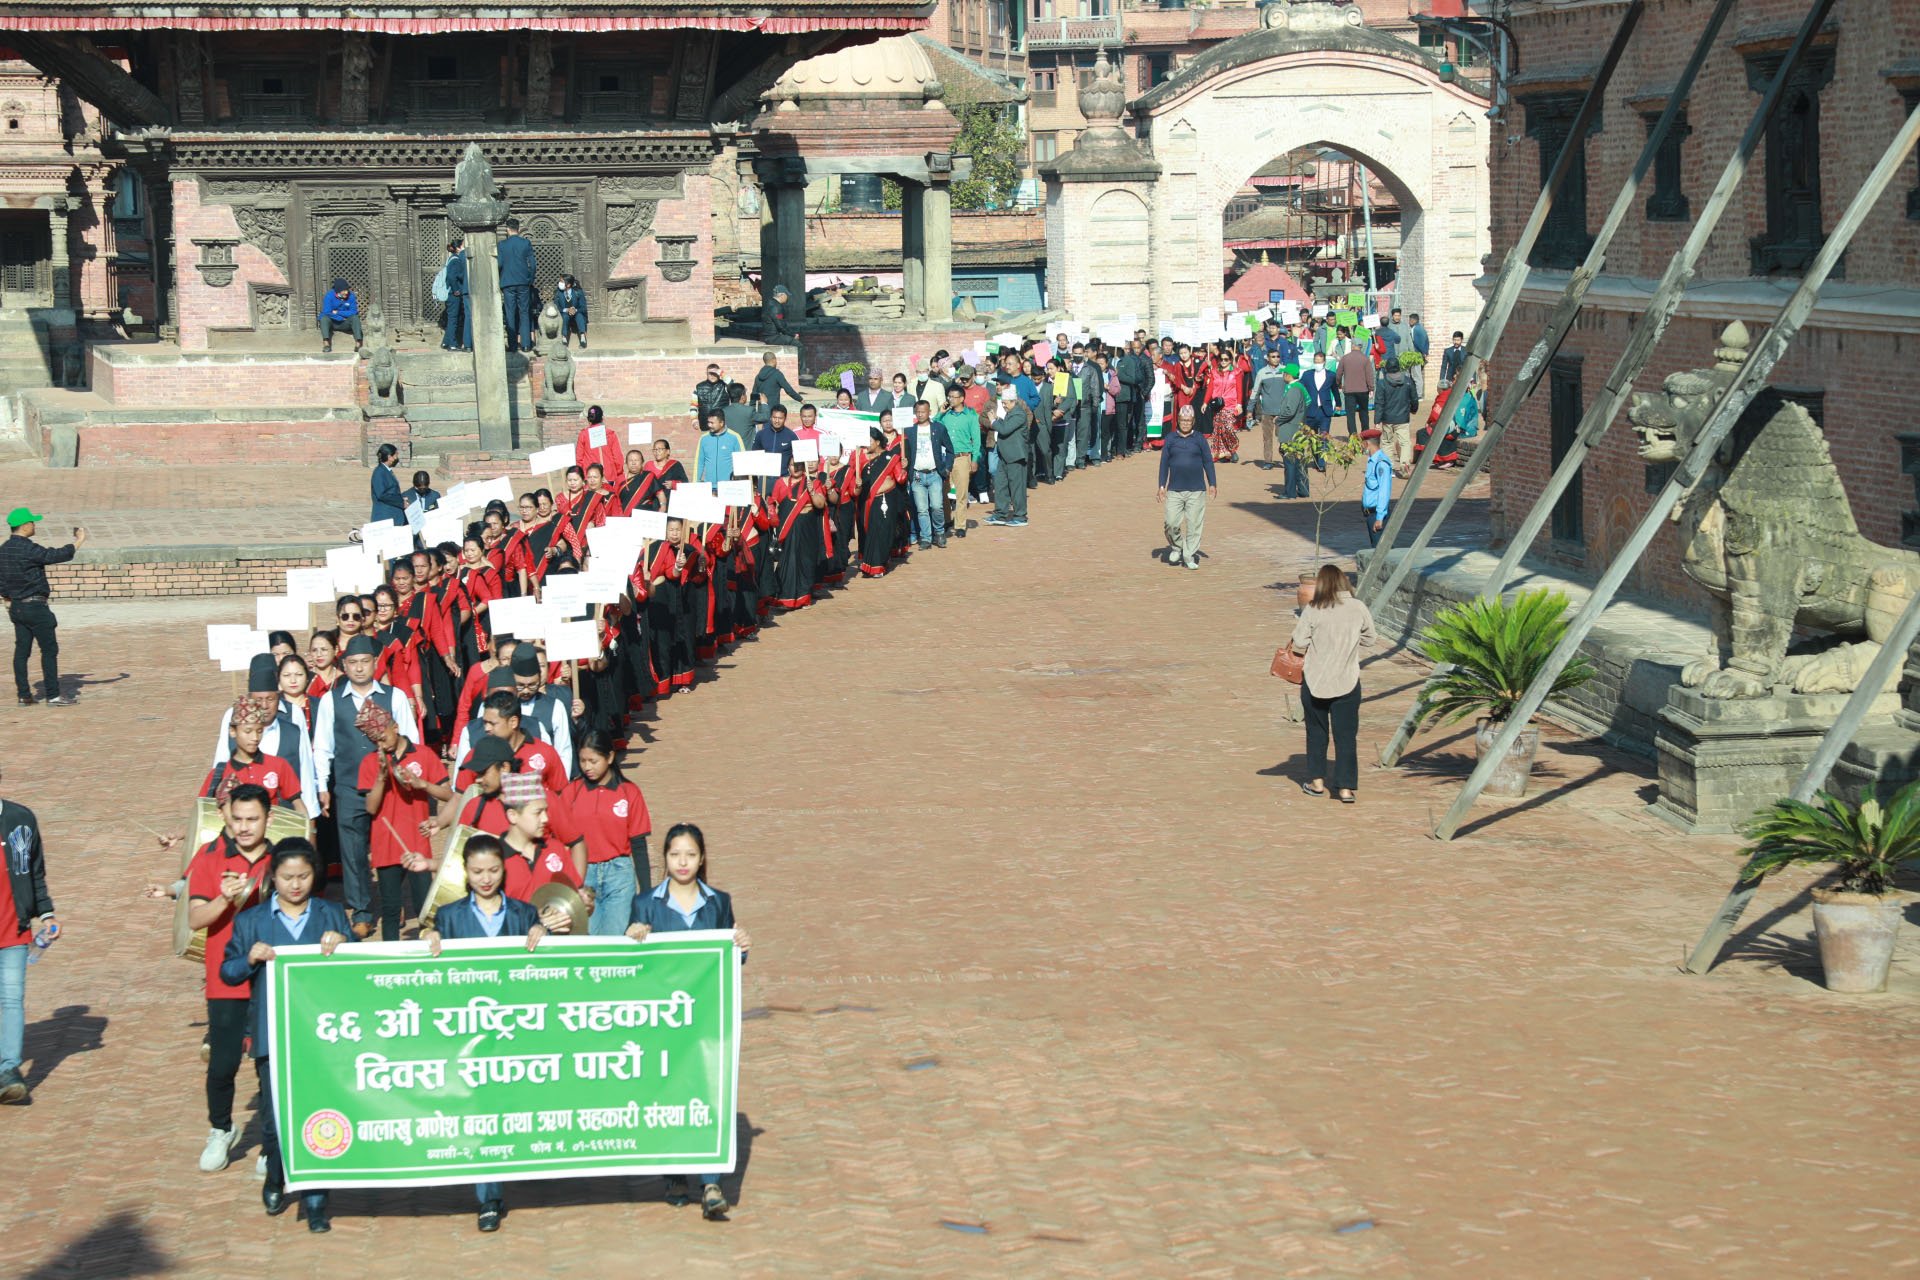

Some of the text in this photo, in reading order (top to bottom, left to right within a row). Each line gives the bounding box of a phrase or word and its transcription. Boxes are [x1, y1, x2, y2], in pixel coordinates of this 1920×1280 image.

[574, 966, 584, 981] र
[315, 1011, 362, 1043] ६६
[432, 995, 548, 1040] राष्ट्रिय
[557, 990, 696, 1032] सहकारी
[355, 1051, 448, 1092] दिवस
[457, 1053, 563, 1084] सफल
[357, 1118, 413, 1146] बालाखु
[415, 1110, 460, 1138] गणेश
[463, 1114, 499, 1136] बचत
[502, 1112, 533, 1135] तथा
[536, 1109, 573, 1132] ऋण
[576, 1100, 640, 1131] सहकारी
[643, 1101, 685, 1128] संस्था
[689, 1097, 712, 1127] लि.
